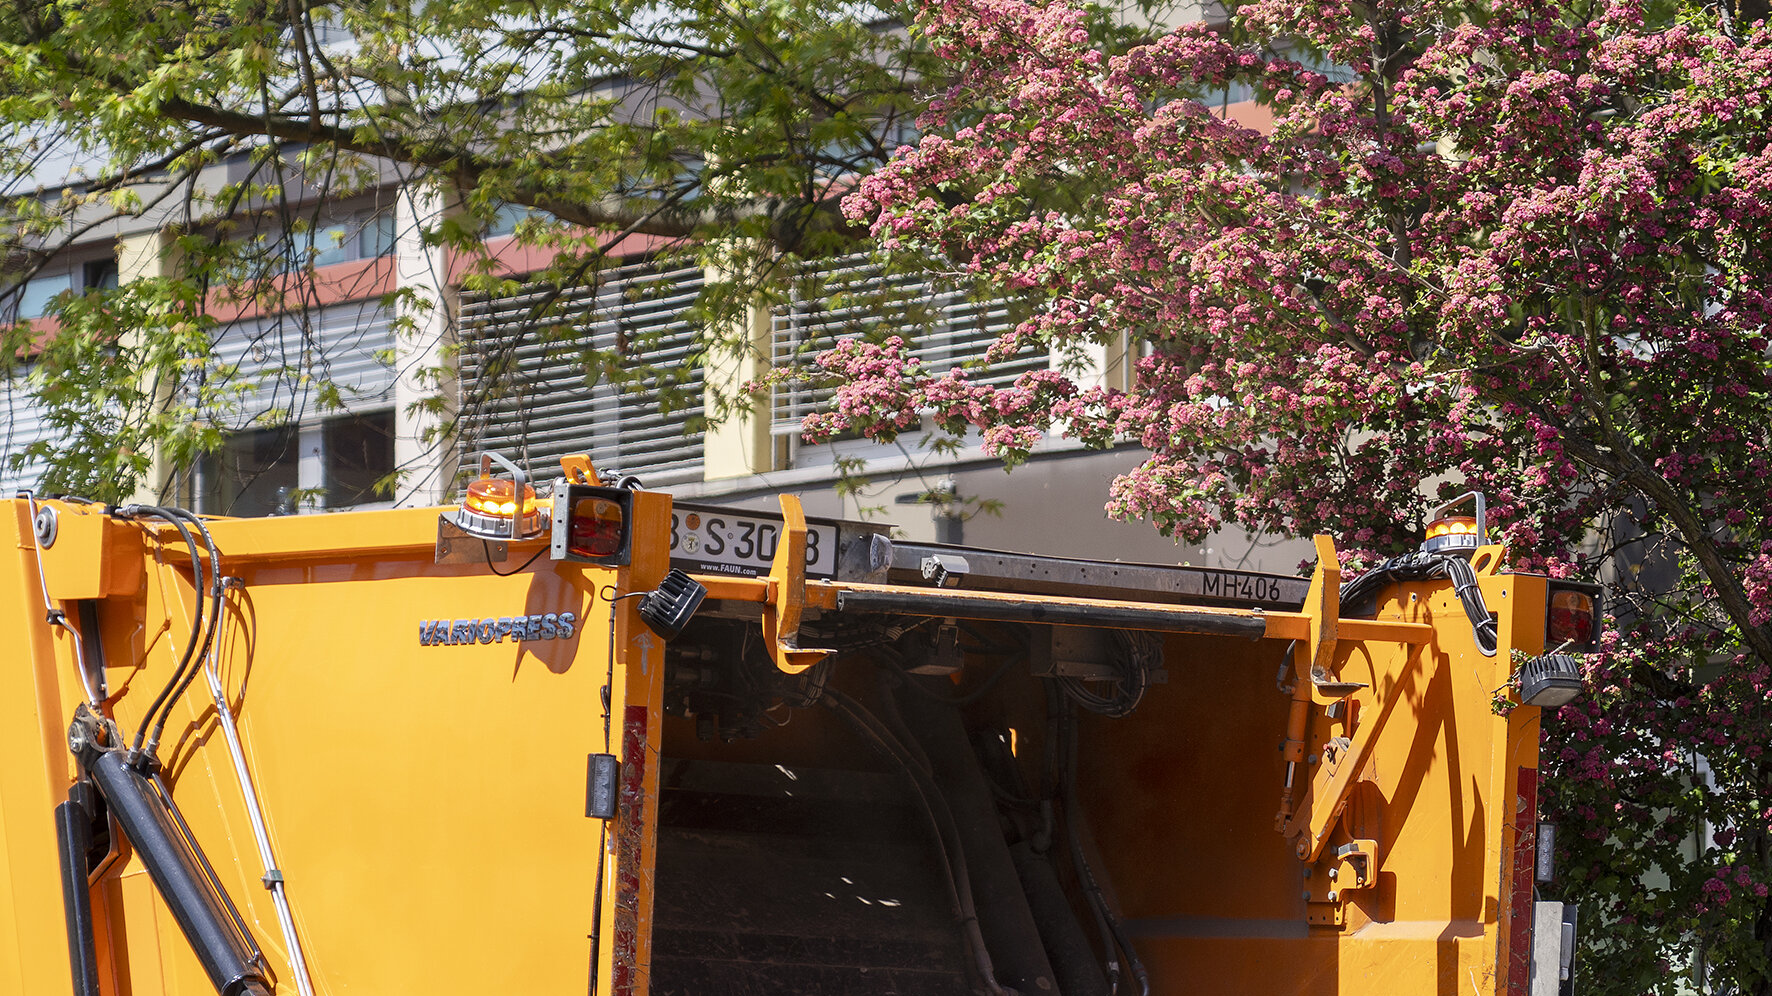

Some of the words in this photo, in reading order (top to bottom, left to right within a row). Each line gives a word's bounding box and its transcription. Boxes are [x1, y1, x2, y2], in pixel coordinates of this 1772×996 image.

[734, 521, 820, 566] 308
[700, 563, 757, 576] www.FAUN.com
[419, 612, 575, 646] VARIOPRESS
